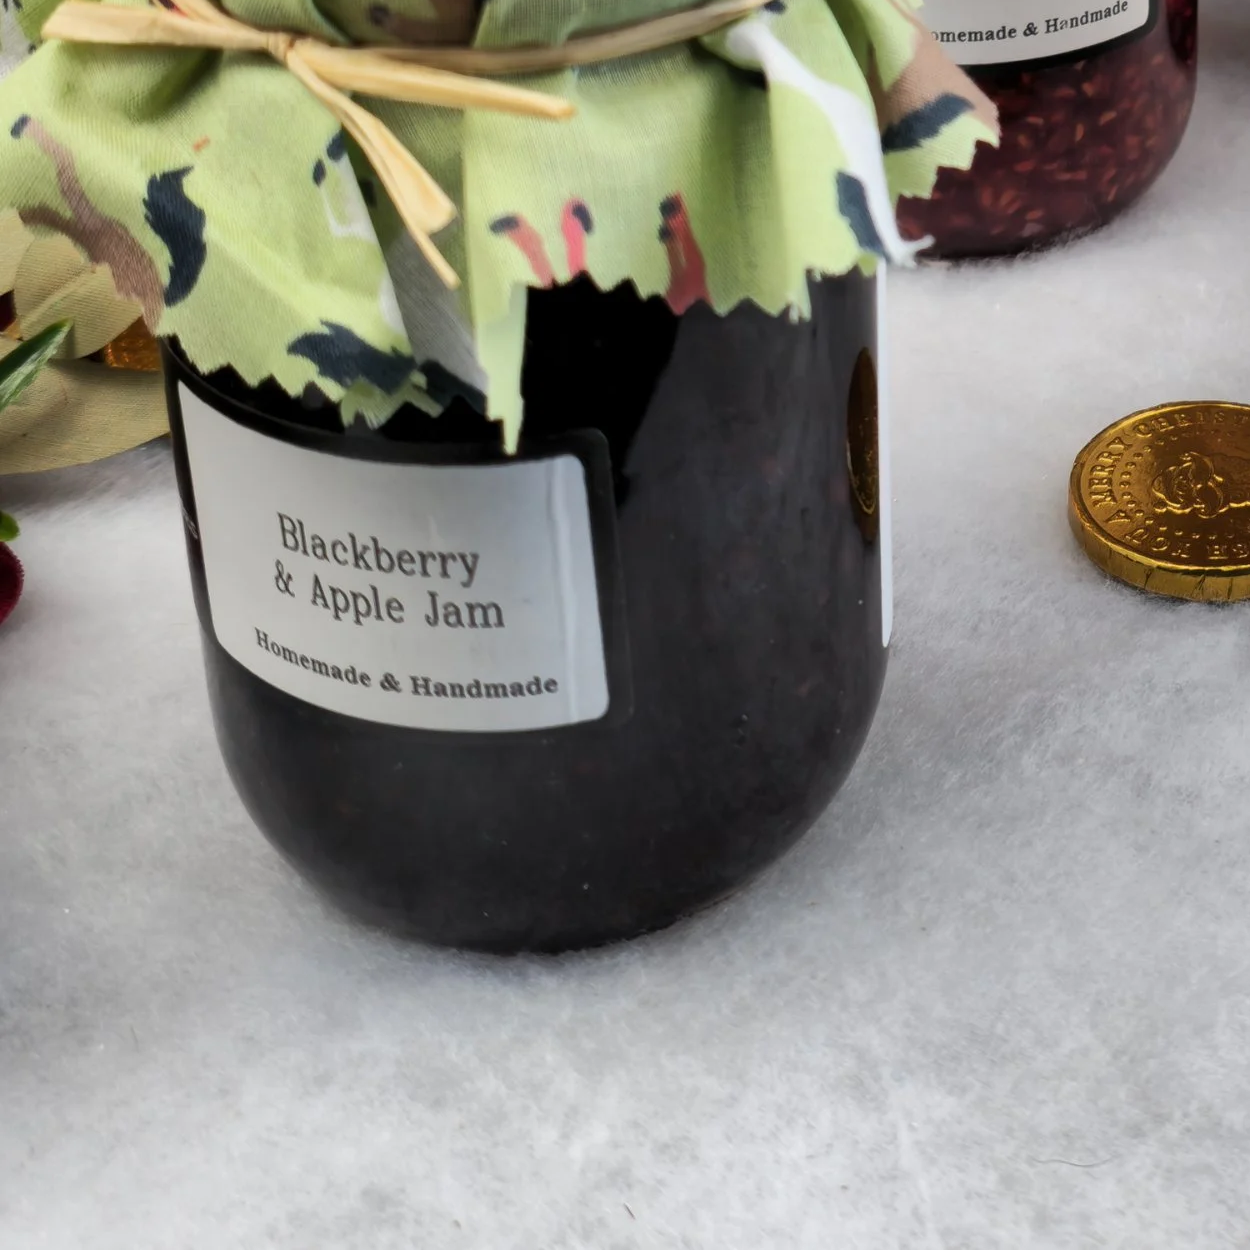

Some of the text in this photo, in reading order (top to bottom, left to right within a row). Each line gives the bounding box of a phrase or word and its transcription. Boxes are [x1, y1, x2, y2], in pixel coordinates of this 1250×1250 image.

[1023, 22, 1040, 37] &
[1044, 0, 1129, 34] Handmade
[1088, 436, 1133, 508] MERRY
[277, 512, 480, 588] Blackberry
[1105, 509, 1131, 524] A
[274, 559, 505, 629] & Apple Jam
[254, 627, 559, 699] Homemade & Handmade
